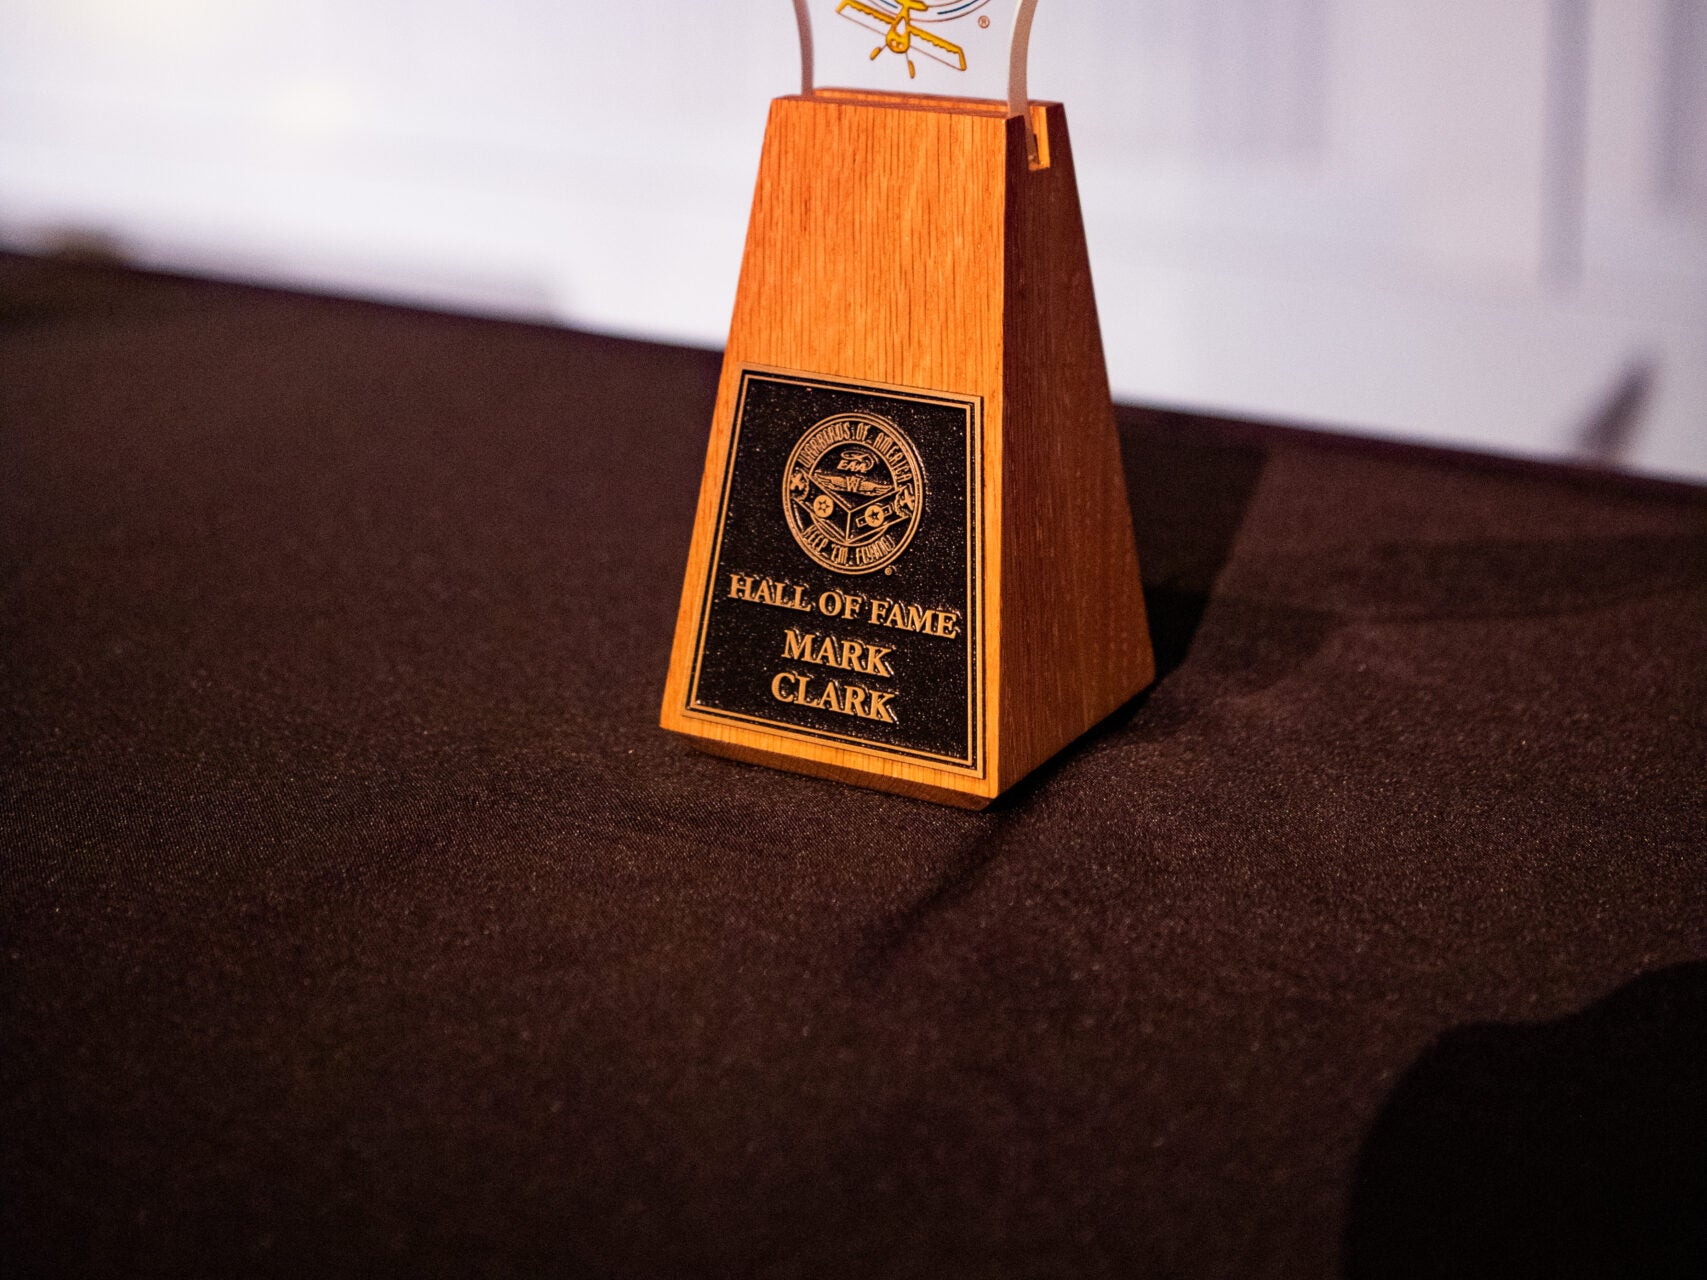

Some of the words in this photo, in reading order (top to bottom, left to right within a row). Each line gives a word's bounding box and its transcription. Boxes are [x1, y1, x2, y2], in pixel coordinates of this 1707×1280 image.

[837, 459, 867, 473] EAA
[855, 422, 871, 442] OF
[872, 432, 912, 483] AMERICA
[728, 574, 812, 612] HALL
[818, 591, 862, 620] OF
[867, 599, 957, 639] FAME
[781, 629, 893, 678] MARK
[771, 672, 896, 724] CLARK
